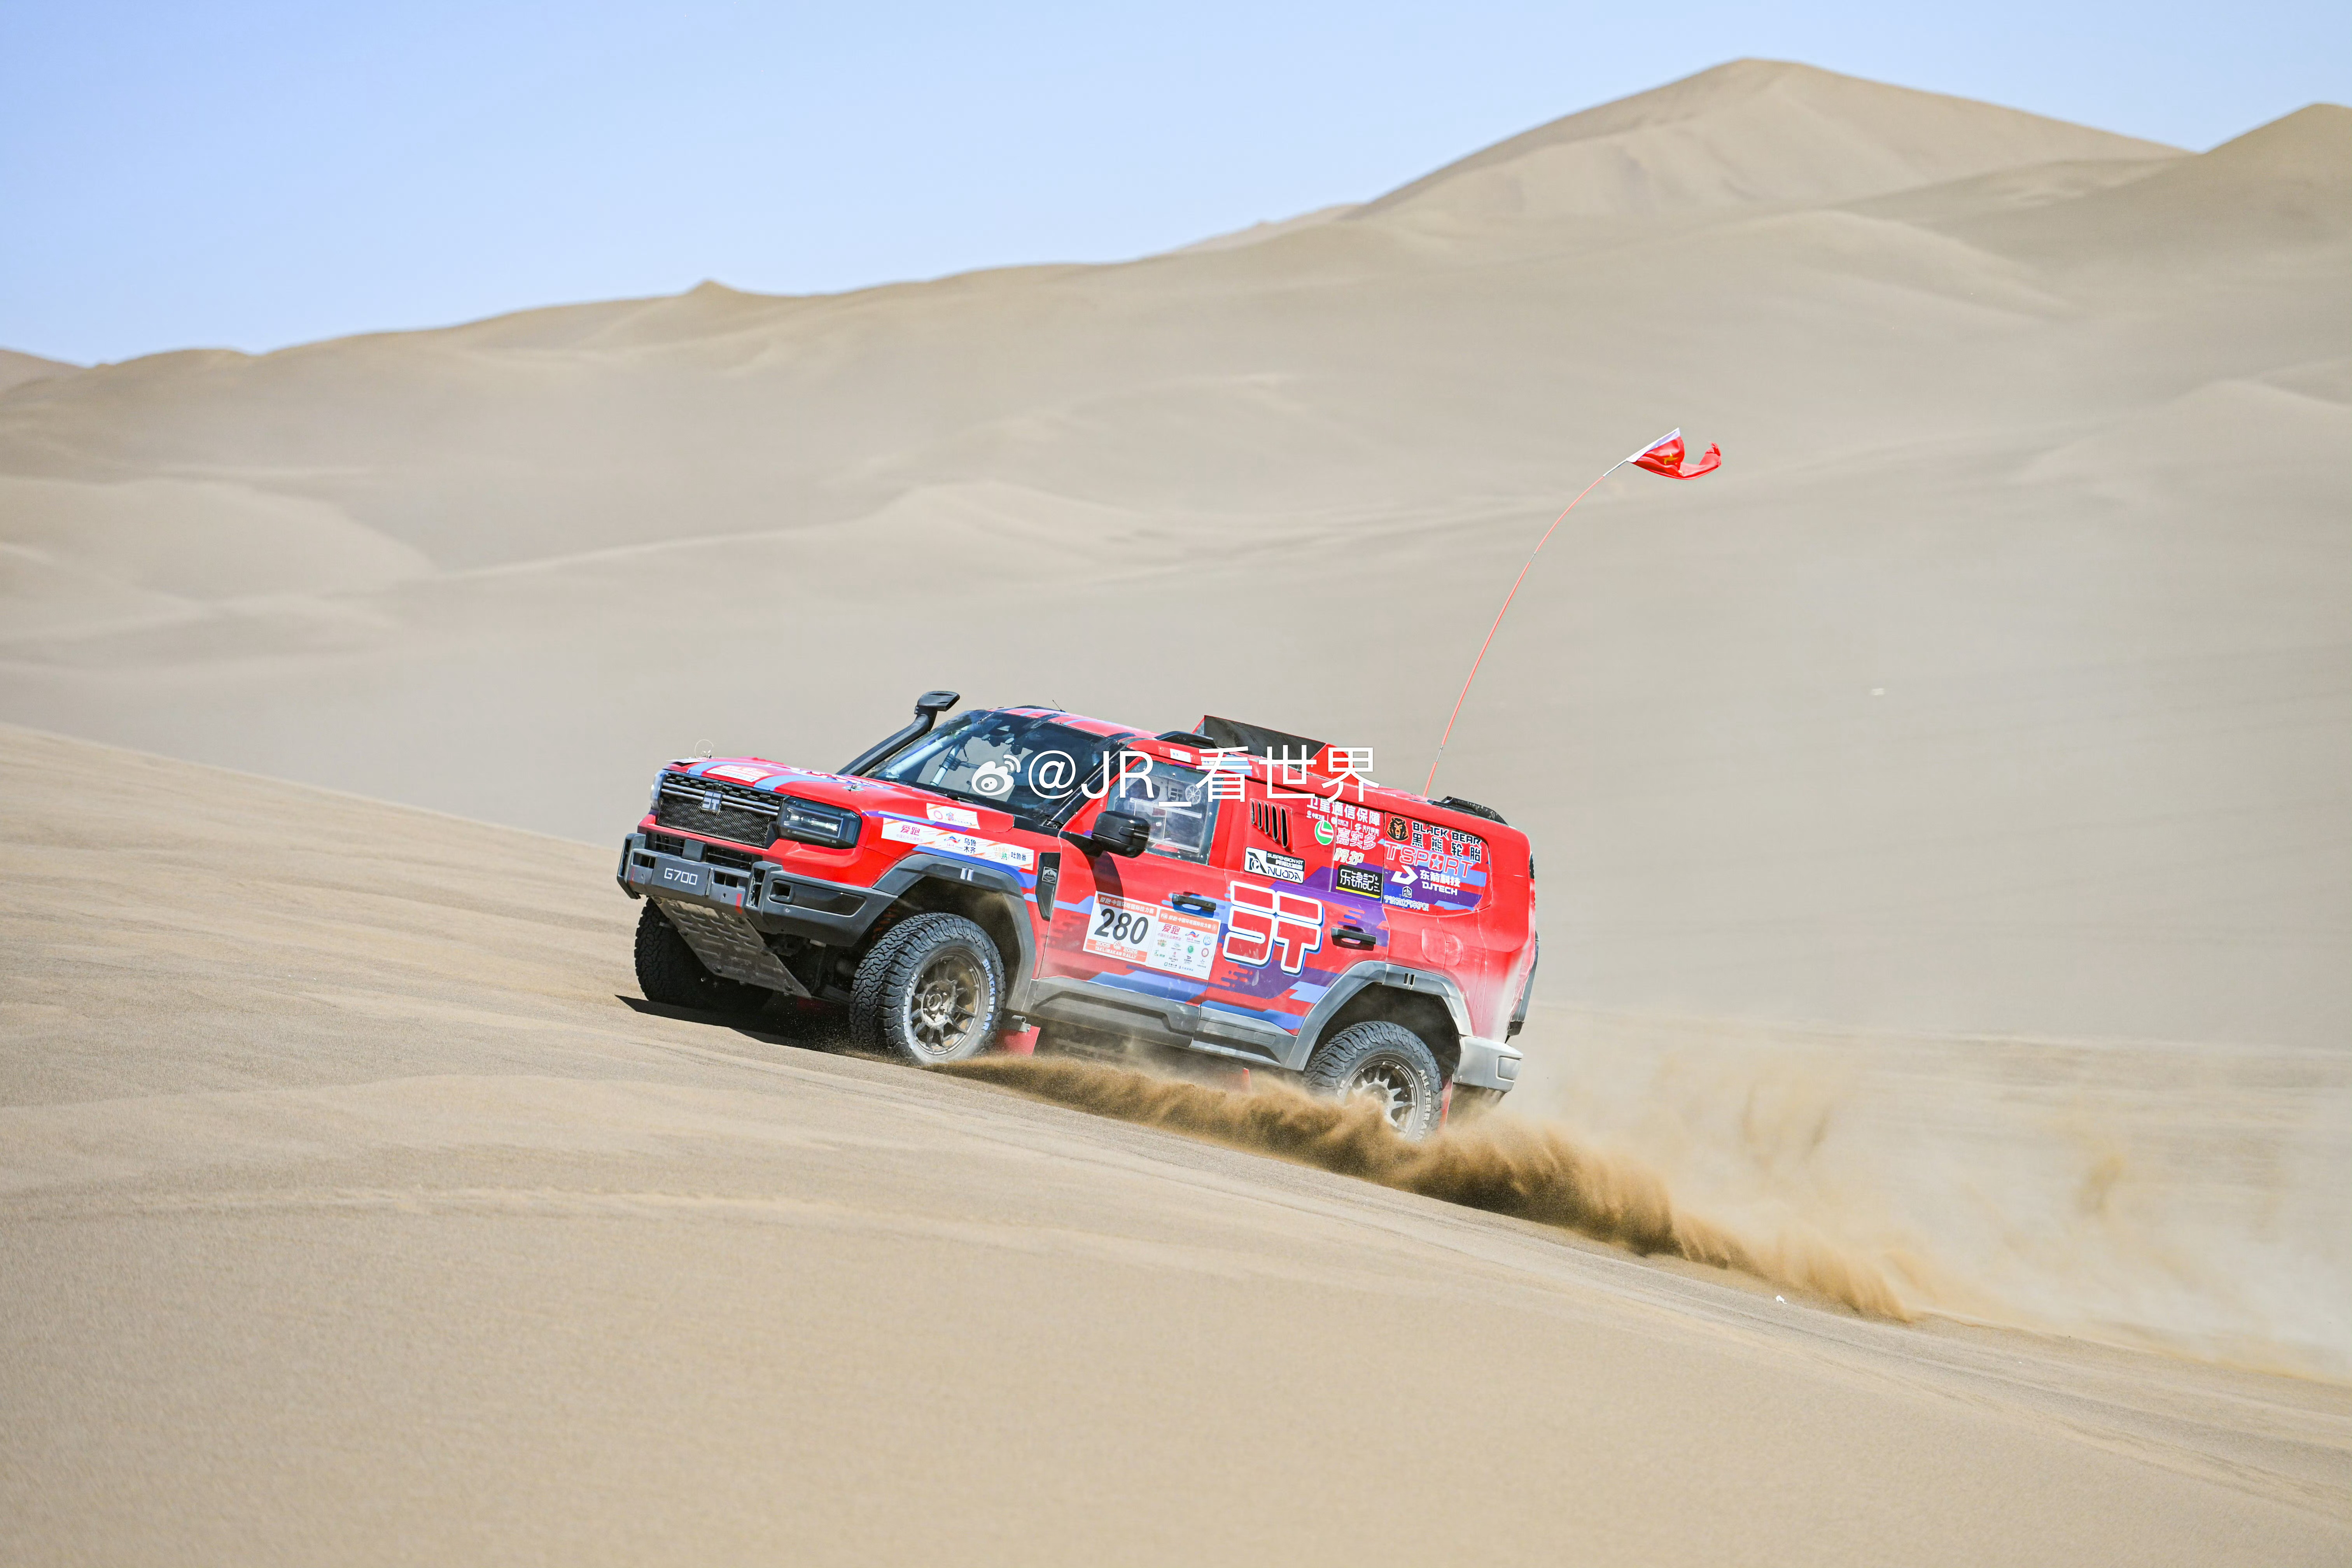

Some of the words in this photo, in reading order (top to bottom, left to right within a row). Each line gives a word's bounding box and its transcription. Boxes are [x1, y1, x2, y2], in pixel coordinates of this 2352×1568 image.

[1307, 796, 1380, 826] 卫星通信保障
[900, 824, 921, 836] 爱跑
[1336, 827, 1376, 850] 嘉实多
[1412, 821, 1449, 841] BLACK
[1451, 831, 1482, 849] BEAR
[1011, 852, 1026, 861] 吐鲁番
[1267, 853, 1296, 864] SUSPENSION
[1333, 847, 1365, 866] 极护
[664, 867, 698, 886] G700
[1420, 870, 1461, 887] 东箭科技
[1422, 881, 1458, 896] DJTECH
[1094, 908, 1148, 944] 280
[1162, 924, 1181, 935] 爱跑
[1095, 946, 1122, 956] TAKLIMAKAN
[1418, 1069, 1430, 1090] ALL
